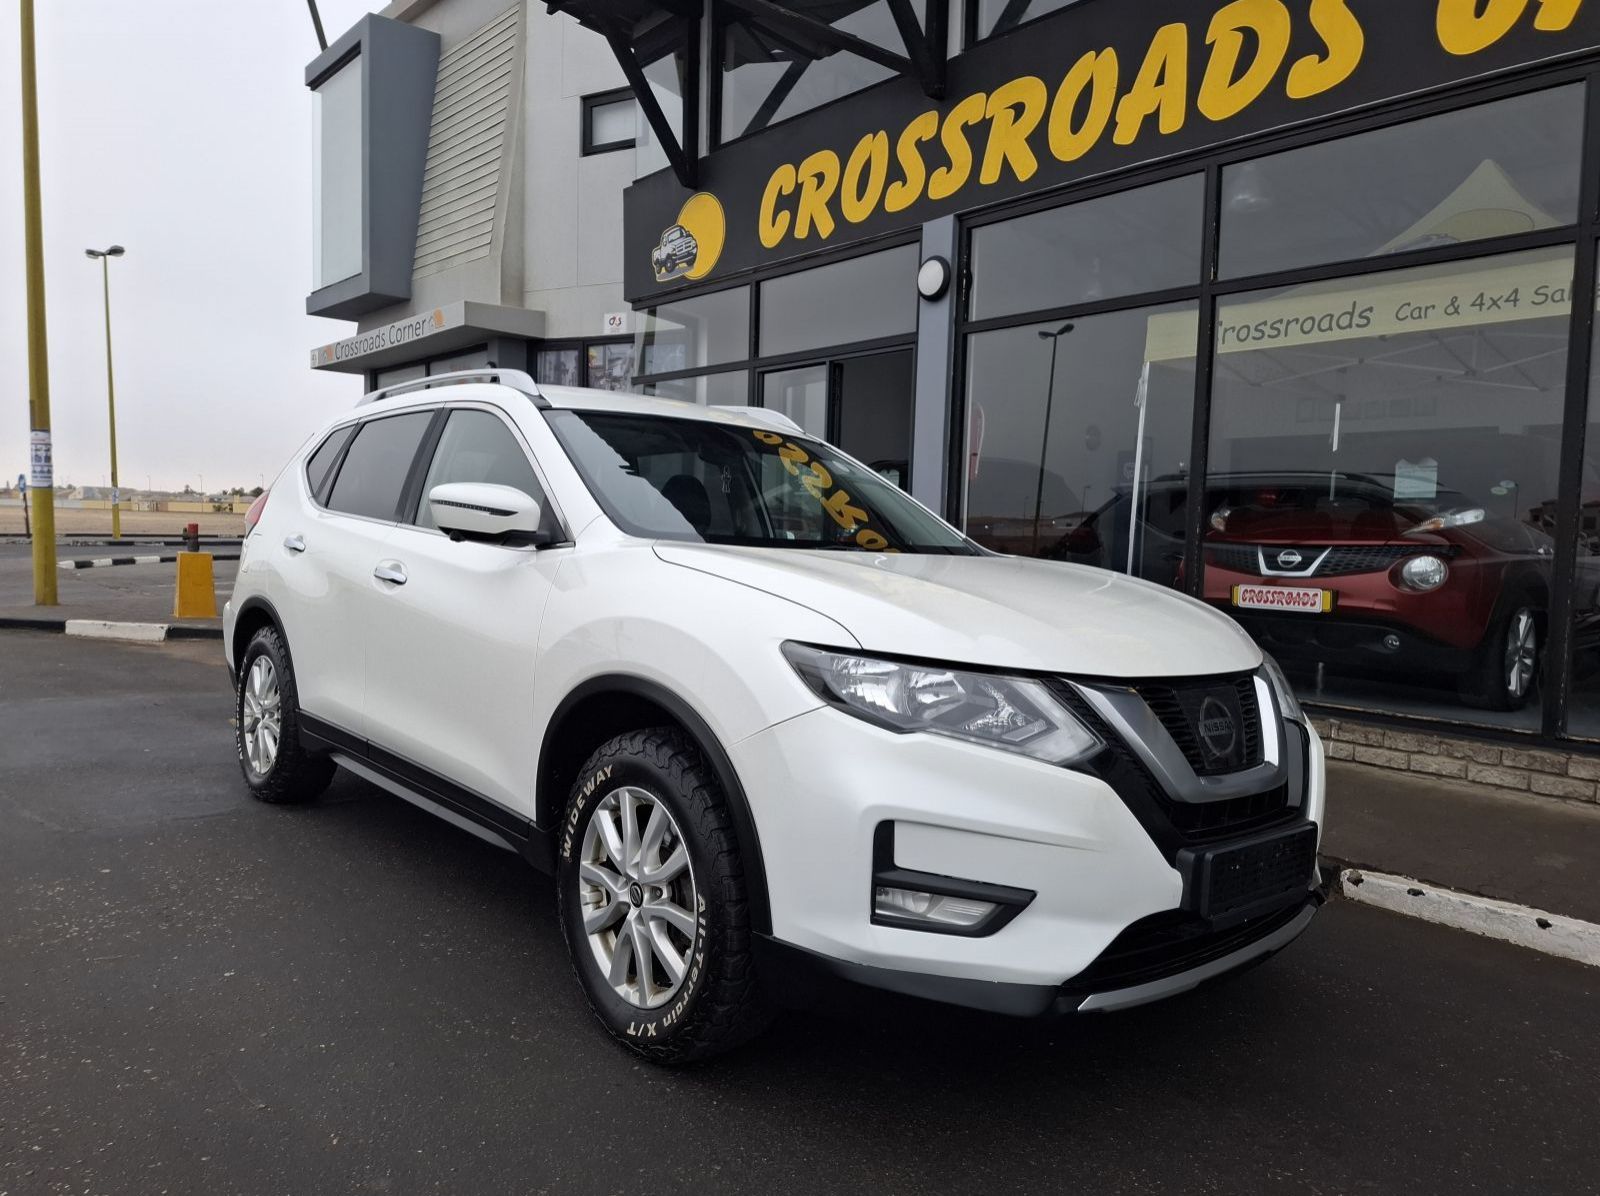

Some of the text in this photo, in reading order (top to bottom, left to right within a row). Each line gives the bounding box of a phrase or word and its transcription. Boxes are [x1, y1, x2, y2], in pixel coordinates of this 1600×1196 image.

[758, 0, 1364, 249] CROSSROADS
[334, 330, 386, 360] Crossroads
[388, 318, 426, 345] Corner
[1216, 280, 1573, 345] rossroads Car & 4x4 Sal
[1241, 588, 1319, 607] CROSSROADS
[563, 764, 613, 857] WIDEWAY
[627, 893, 706, 1037] All-Terrain X/T
